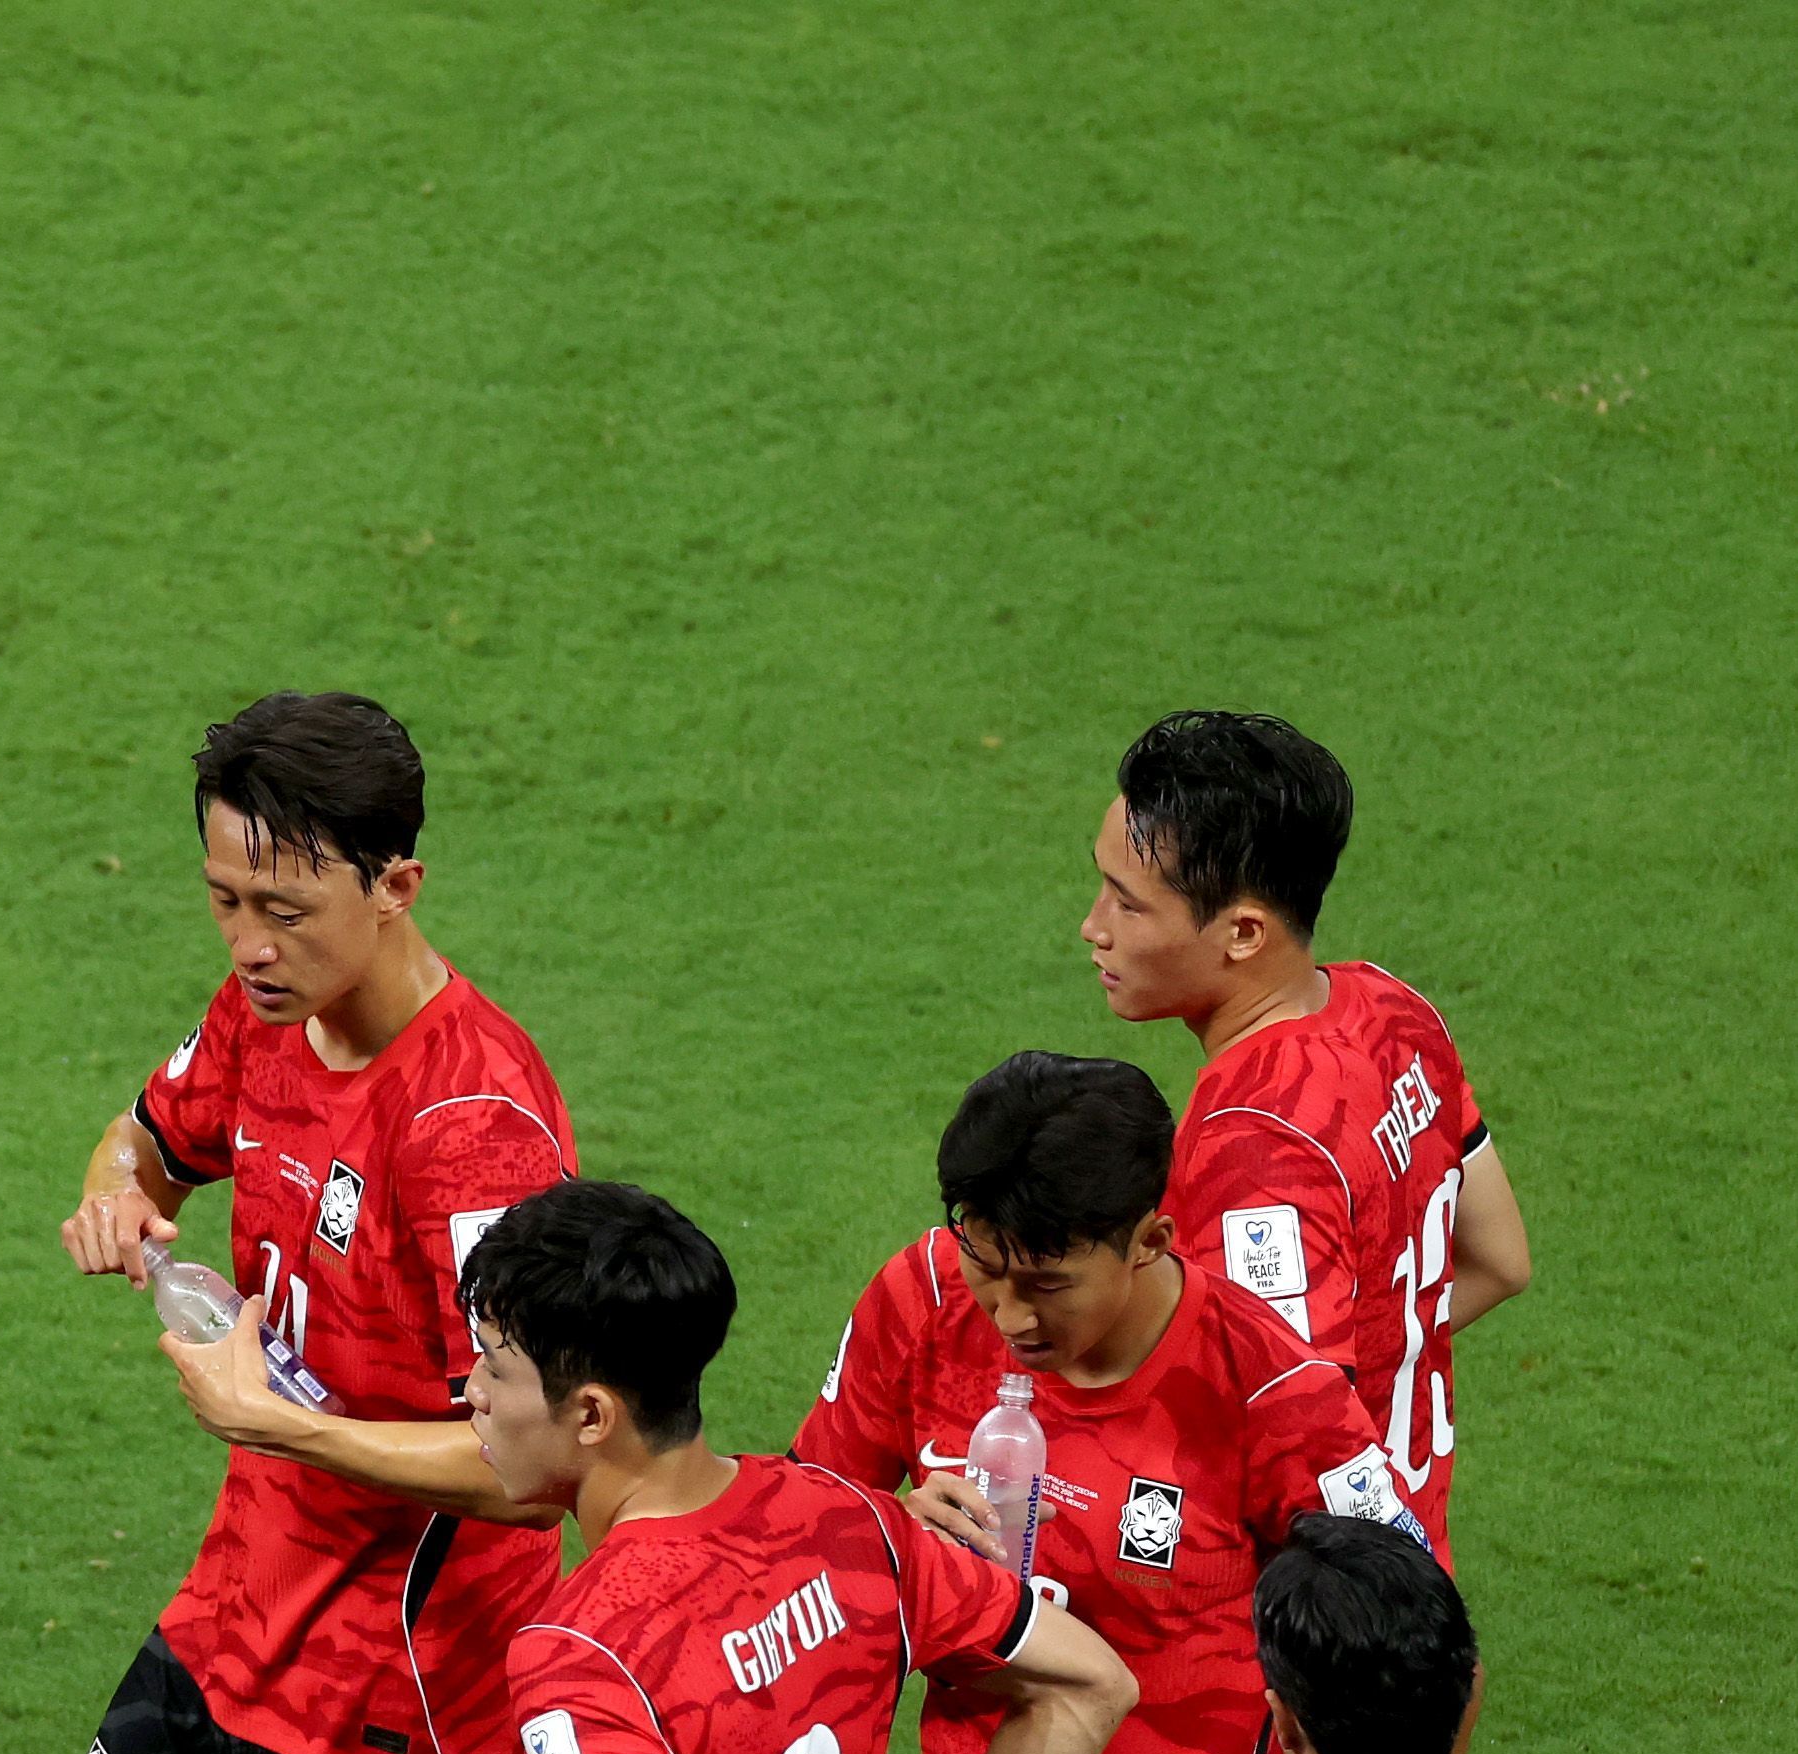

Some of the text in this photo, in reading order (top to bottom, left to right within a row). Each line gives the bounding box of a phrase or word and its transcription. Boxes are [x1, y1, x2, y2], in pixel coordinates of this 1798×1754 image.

[1247, 1261, 1282, 1280] PEACE
[1257, 1280, 1275, 1288] FIFA
[1019, 1473, 1041, 1584] martwater
